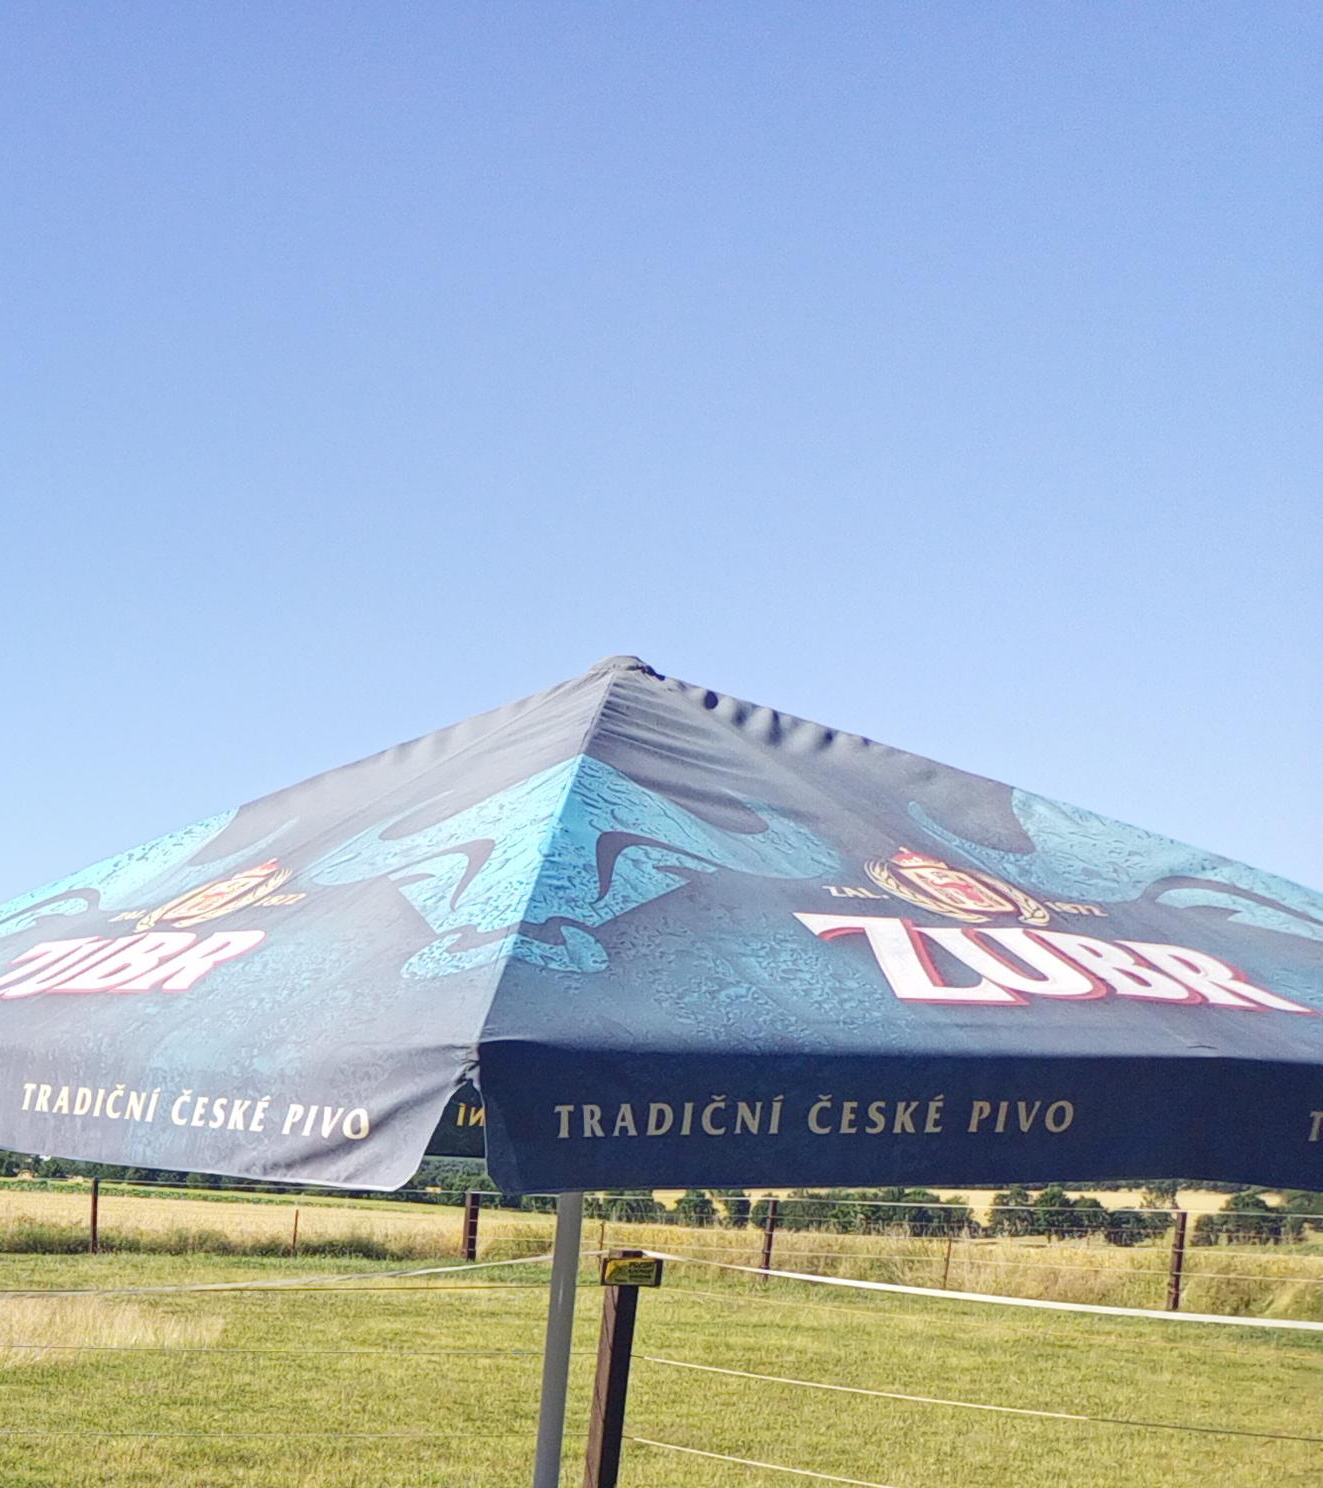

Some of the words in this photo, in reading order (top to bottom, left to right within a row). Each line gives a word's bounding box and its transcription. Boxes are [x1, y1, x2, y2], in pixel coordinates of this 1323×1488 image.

[793, 912, 1323, 1017] ZUBR
[21, 1083, 161, 1122] TRADIČNÍ
[170, 1089, 271, 1132] ČESKÉ
[282, 1103, 370, 1140] PIVO
[554, 1094, 785, 1139] TRADIČNÍ
[807, 1094, 945, 1135] ČESKÉ
[967, 1100, 1074, 1133] PIVO
